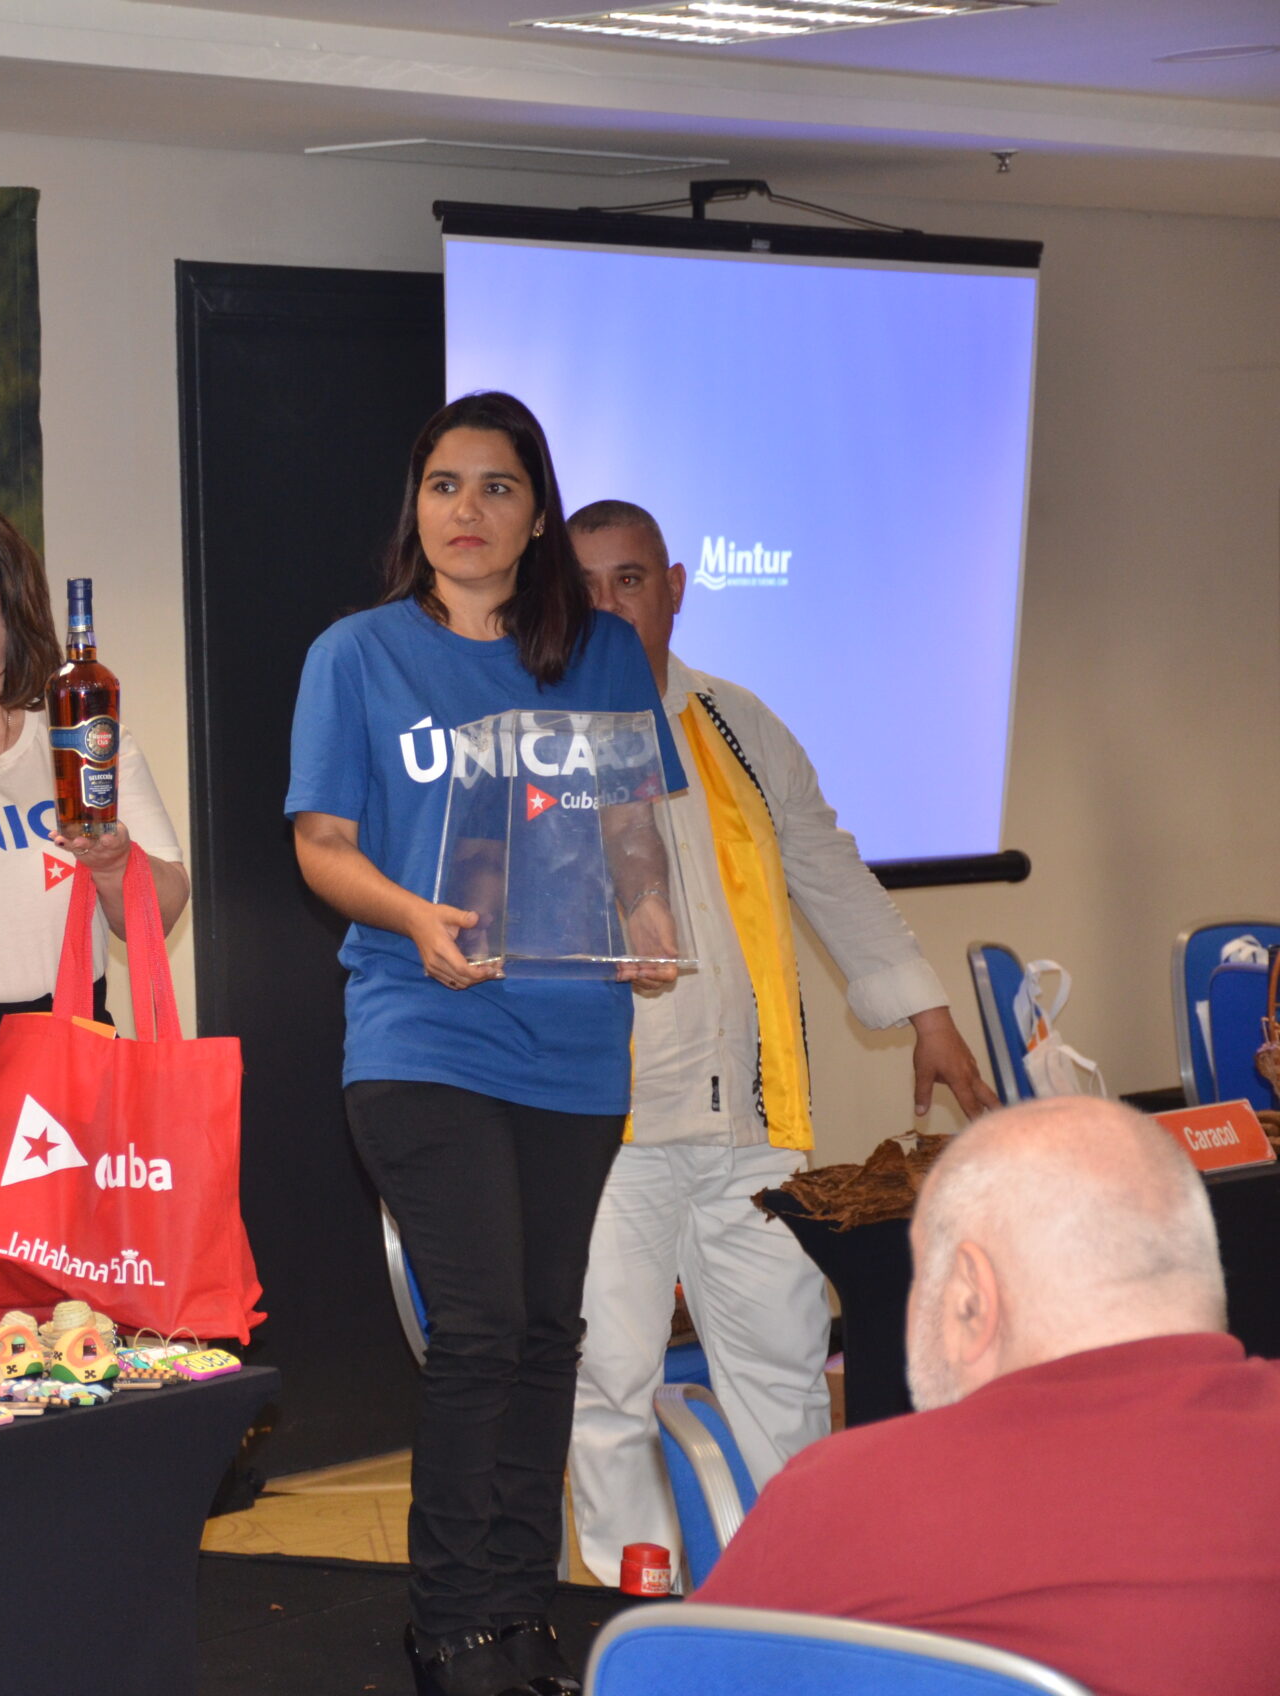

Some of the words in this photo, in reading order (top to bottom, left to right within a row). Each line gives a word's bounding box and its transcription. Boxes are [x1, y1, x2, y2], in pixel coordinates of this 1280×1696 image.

[700, 536, 792, 574] Mintur
[399, 715, 597, 784] ÚNICA
[560, 790, 600, 810] Cuba
[1183, 1120, 1241, 1151] Caracol
